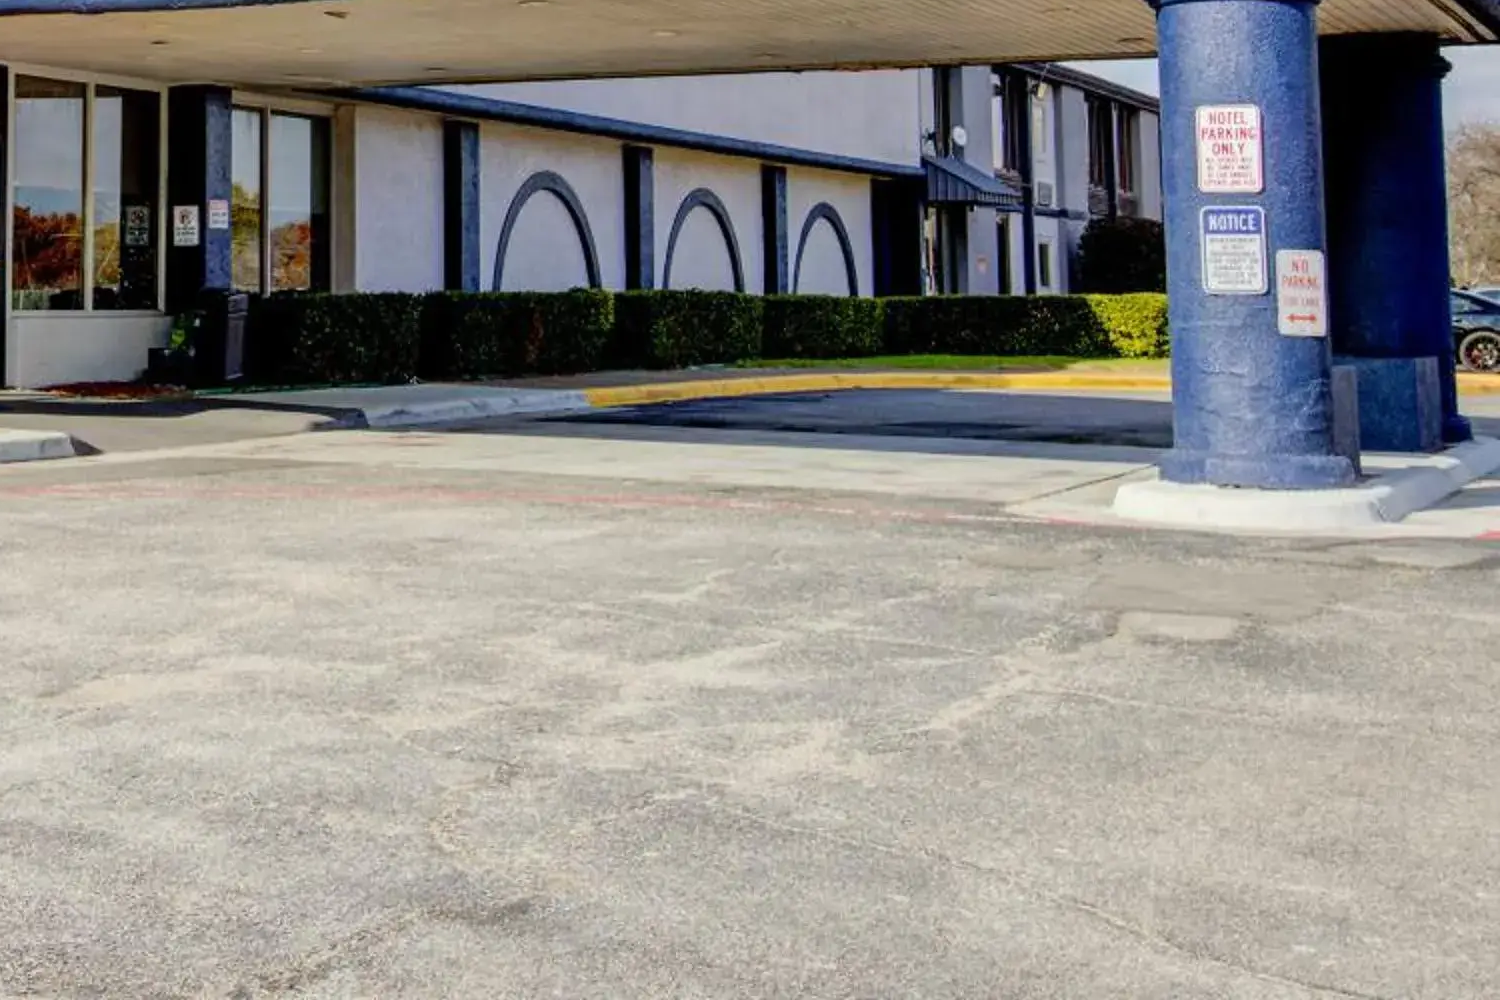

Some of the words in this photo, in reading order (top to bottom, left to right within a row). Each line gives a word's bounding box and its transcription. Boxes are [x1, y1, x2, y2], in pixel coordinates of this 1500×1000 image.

[1200, 127, 1257, 141] PARKING
[1211, 142, 1245, 156] ONLY
[1209, 213, 1257, 231] NOTICE
[1291, 259, 1309, 274] NO
